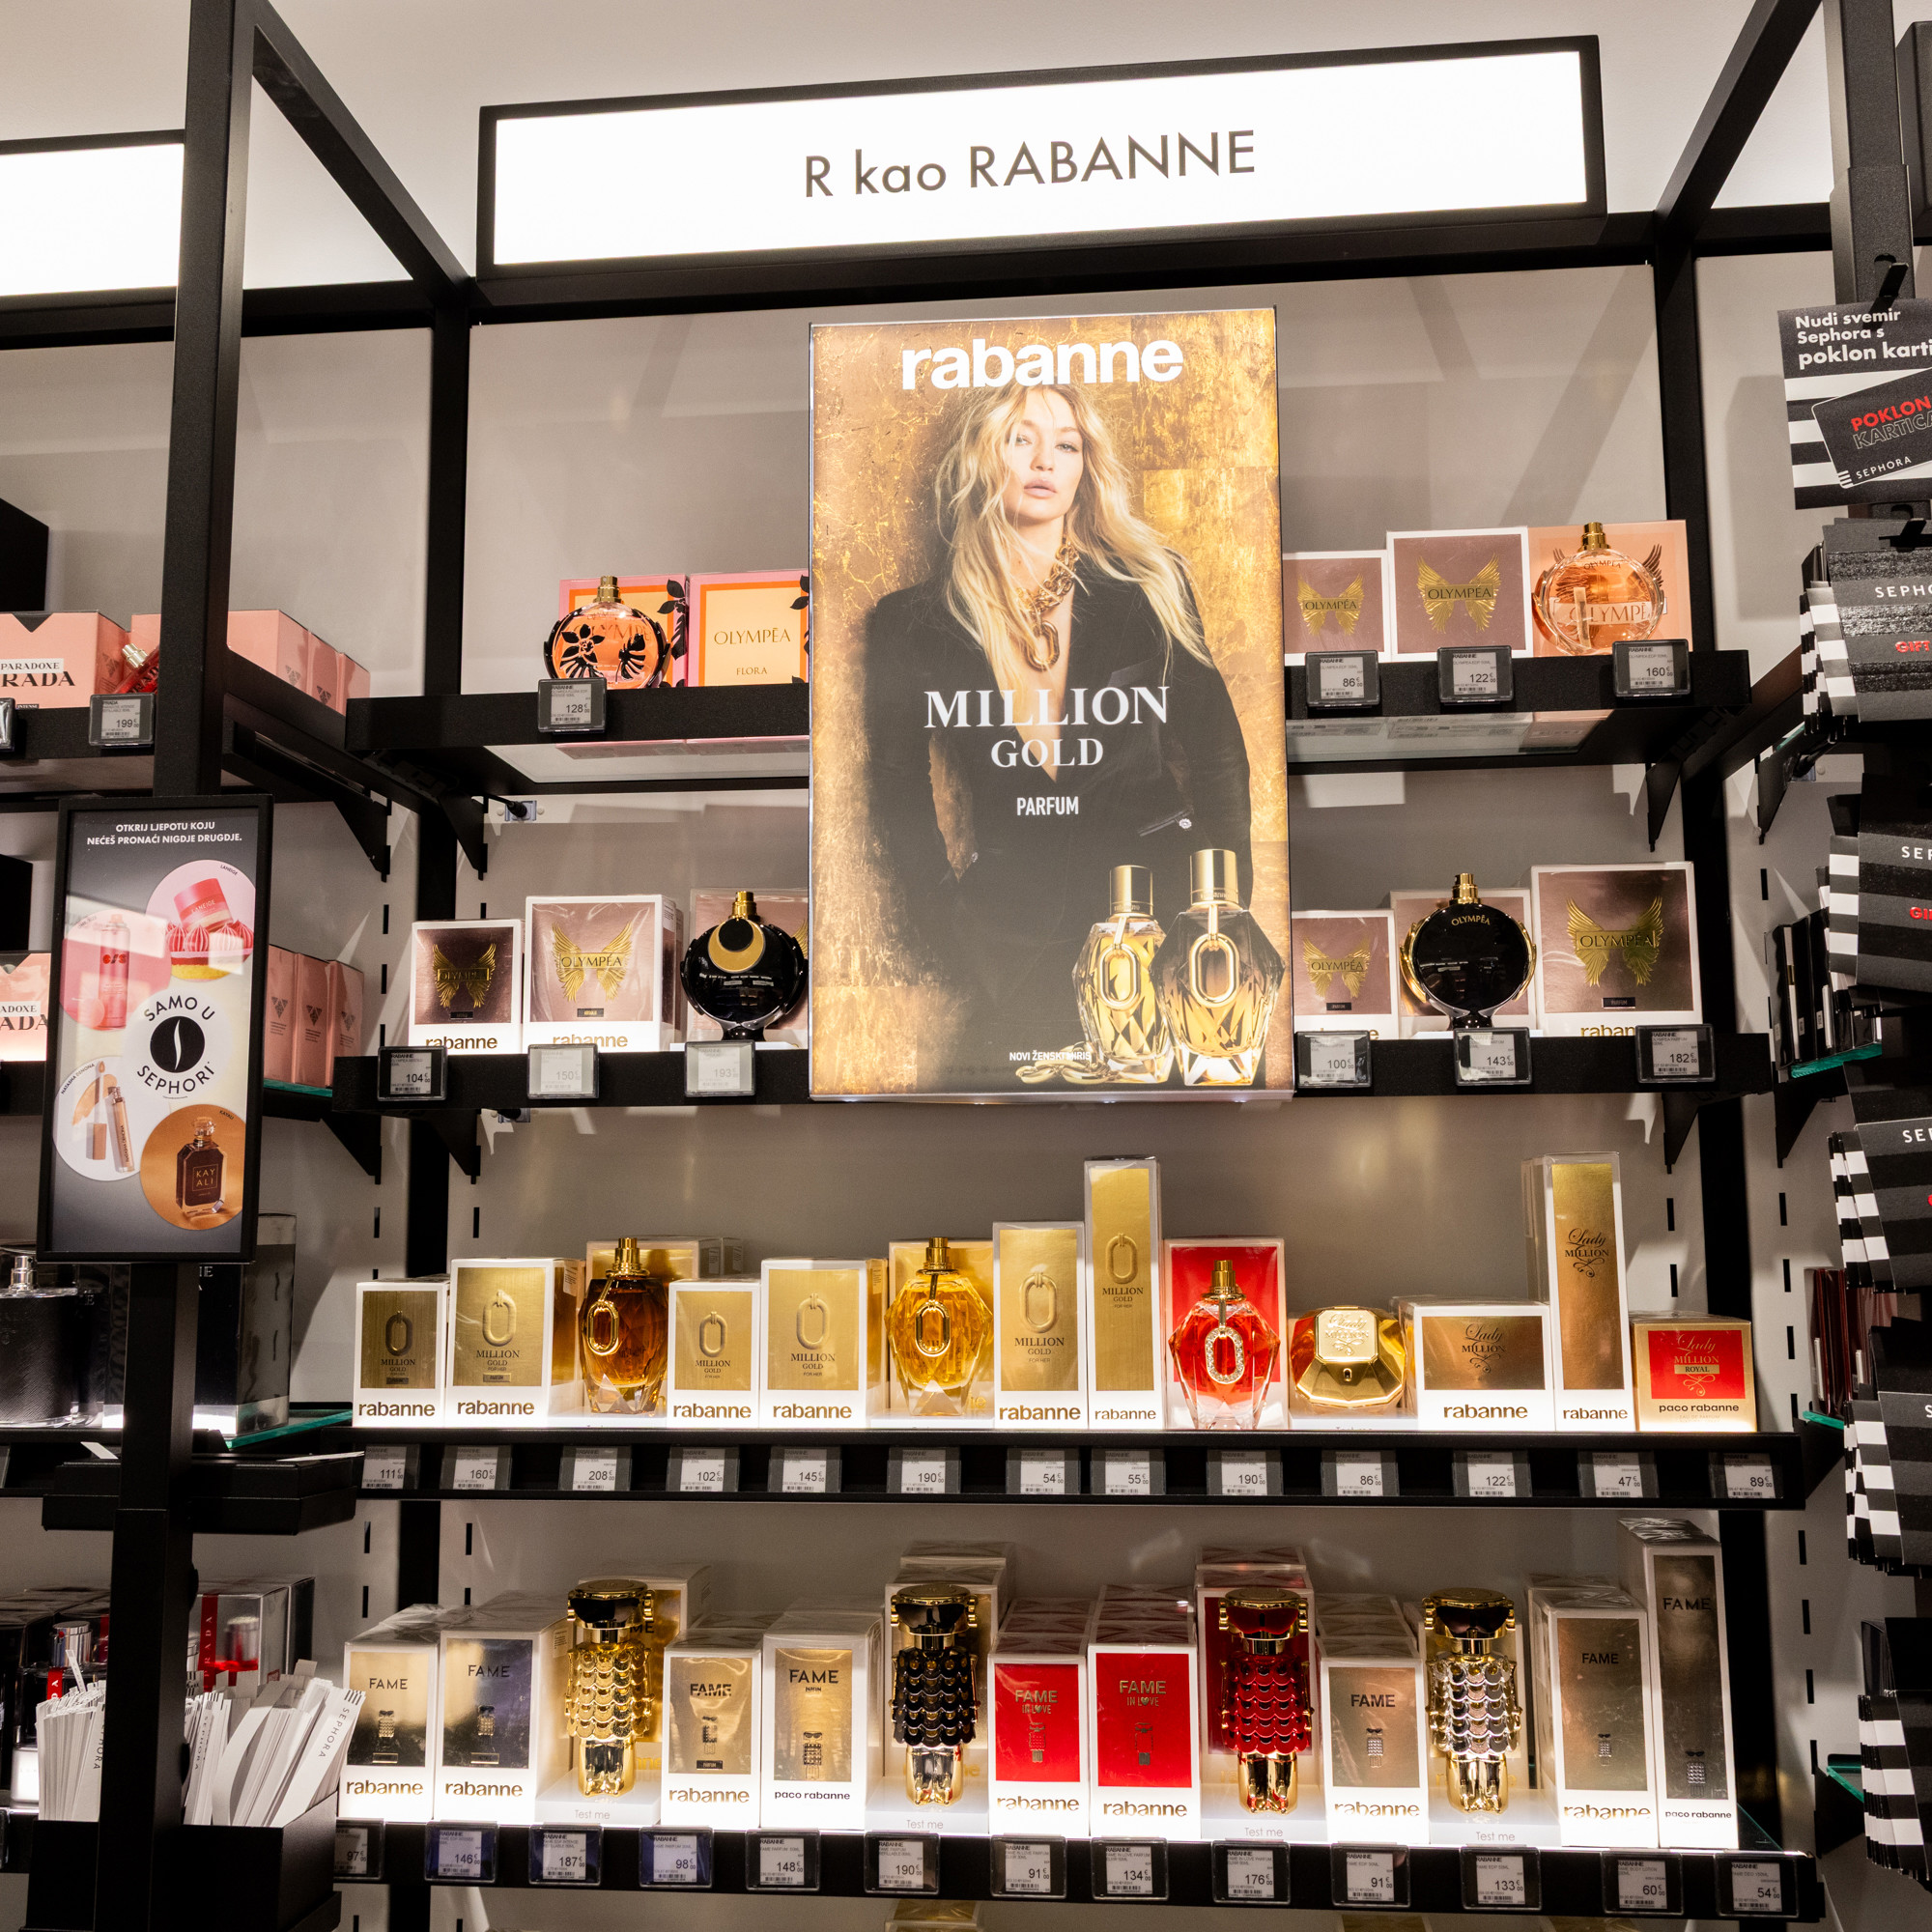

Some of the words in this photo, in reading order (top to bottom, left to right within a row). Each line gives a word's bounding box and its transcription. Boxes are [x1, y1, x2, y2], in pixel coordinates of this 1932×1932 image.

[806, 156, 834, 197] R
[855, 149, 947, 194] kao
[971, 129, 1255, 187] RABANNE
[1796, 313, 1837, 328] Nudi
[1843, 308, 1900, 325] svemir
[1798, 328, 1871, 346] Sephora
[1877, 328, 1884, 337] s
[1799, 345, 1876, 370] poklon
[902, 338, 1183, 389] rabanne
[1851, 396, 1931, 432] POKLON
[1857, 457, 1911, 479] SEPHORA
[1895, 640, 1930, 653] GIFT
[736, 667, 767, 675] FLORA
[1646, 667, 1665, 677] 160
[1343, 677, 1355, 688] 86
[1469, 673, 1489, 683] 122
[566, 704, 582, 713] 128
[924, 686, 1169, 728] MILLION
[991, 738, 1103, 767] GOLD
[1017, 797, 1079, 816] PARFUM
[87, 835, 115, 844] NEĆEŠ
[118, 834, 159, 844] PRONAĆI
[145, 995, 197, 1021] SAMO
[202, 1007, 214, 1020] U
[426, 1035, 497, 1049] rabanne
[553, 1034, 628, 1047] rabanne
[1009, 1052, 1030, 1061] NOVI
[1033, 1050, 1065, 1060] ŽENSKI
[1066, 1051, 1091, 1060] MIRIS
[1487, 1056, 1506, 1065] 143
[1669, 1054, 1690, 1063] 182
[1327, 1059, 1347, 1069] 100
[556, 1070, 575, 1080] 150
[714, 1067, 732, 1077] 193
[137, 1065, 213, 1094] SEPHORI
[406, 1073, 424, 1083] 104
[62, 1076, 76, 1094] NATASHA
[196, 1169, 214, 1178] KAY
[1567, 1228, 1605, 1247] Lady
[1565, 1249, 1609, 1258] MILLION
[1464, 1324, 1502, 1343] Lady
[1014, 1337, 1064, 1347] MILLION
[1678, 1334, 1717, 1354] Lady
[359, 1402, 435, 1416] rabanne
[458, 1401, 534, 1415] rabanne
[673, 1404, 751, 1418] rabanne
[773, 1404, 851, 1418] rabanne
[1000, 1406, 1080, 1420] rabanne
[1443, 1405, 1528, 1418] rabanne
[1563, 1407, 1627, 1420] rabanne
[1660, 1405, 1687, 1413] paco
[1690, 1403, 1739, 1411] rabanne
[1094, 1408, 1156, 1420] rabanne
[381, 1469, 396, 1478] 111
[470, 1469, 488, 1479] 160
[588, 1471, 608, 1480] 208
[697, 1472, 715, 1481] 102
[799, 1472, 817, 1481] 145
[918, 1473, 936, 1482] 190
[1043, 1473, 1056, 1484] 54
[1128, 1474, 1141, 1484] 55
[1238, 1474, 1258, 1484] 190
[1360, 1475, 1374, 1486] 86
[1486, 1475, 1506, 1486] 122
[1618, 1476, 1633, 1487] 47
[1750, 1477, 1764, 1488] 89
[1663, 1598, 1711, 1610] FAME
[1582, 1654, 1619, 1663] FAME
[468, 1665, 510, 1677] FAME
[789, 1670, 838, 1684] FAME
[370, 1679, 408, 1690] FAME
[691, 1684, 731, 1696] FAME
[1120, 1681, 1166, 1694] FAME
[1015, 1690, 1058, 1703] FAME
[1127, 1697, 1134, 1706] IN
[1351, 1694, 1395, 1707] FAME
[319, 1707, 350, 1758] SEPHORA
[347, 1780, 423, 1795] rabanne
[445, 1781, 523, 1797] rabanne
[669, 1789, 749, 1803] rabanne
[805, 1791, 850, 1800] rabanne
[997, 1797, 1079, 1811] rabanne
[1104, 1802, 1187, 1817] rabanne
[1334, 1802, 1420, 1817] rabanne
[575, 1810, 592, 1819] Test
[1564, 1805, 1651, 1821] rabanne
[1665, 1811, 1689, 1820] paco
[906, 1820, 923, 1829] Test
[1244, 1827, 1263, 1836] Test
[1476, 1832, 1496, 1842] Test
[1499, 1833, 1515, 1842] me
[347, 1852, 358, 1861] 97
[455, 1855, 472, 1863] 146
[559, 1857, 577, 1866] 187
[676, 1860, 689, 1869] 98
[777, 1862, 795, 1872] 148
[895, 1865, 915, 1875] 190
[1029, 1869, 1040, 1878] 91
[1123, 1870, 1143, 1881] 134
[1246, 1875, 1264, 1885] 176
[1372, 1878, 1383, 1887] 91
[1495, 1881, 1515, 1890] 133
[1643, 1886, 1657, 1895] 60
[1758, 1888, 1771, 1897] 54
